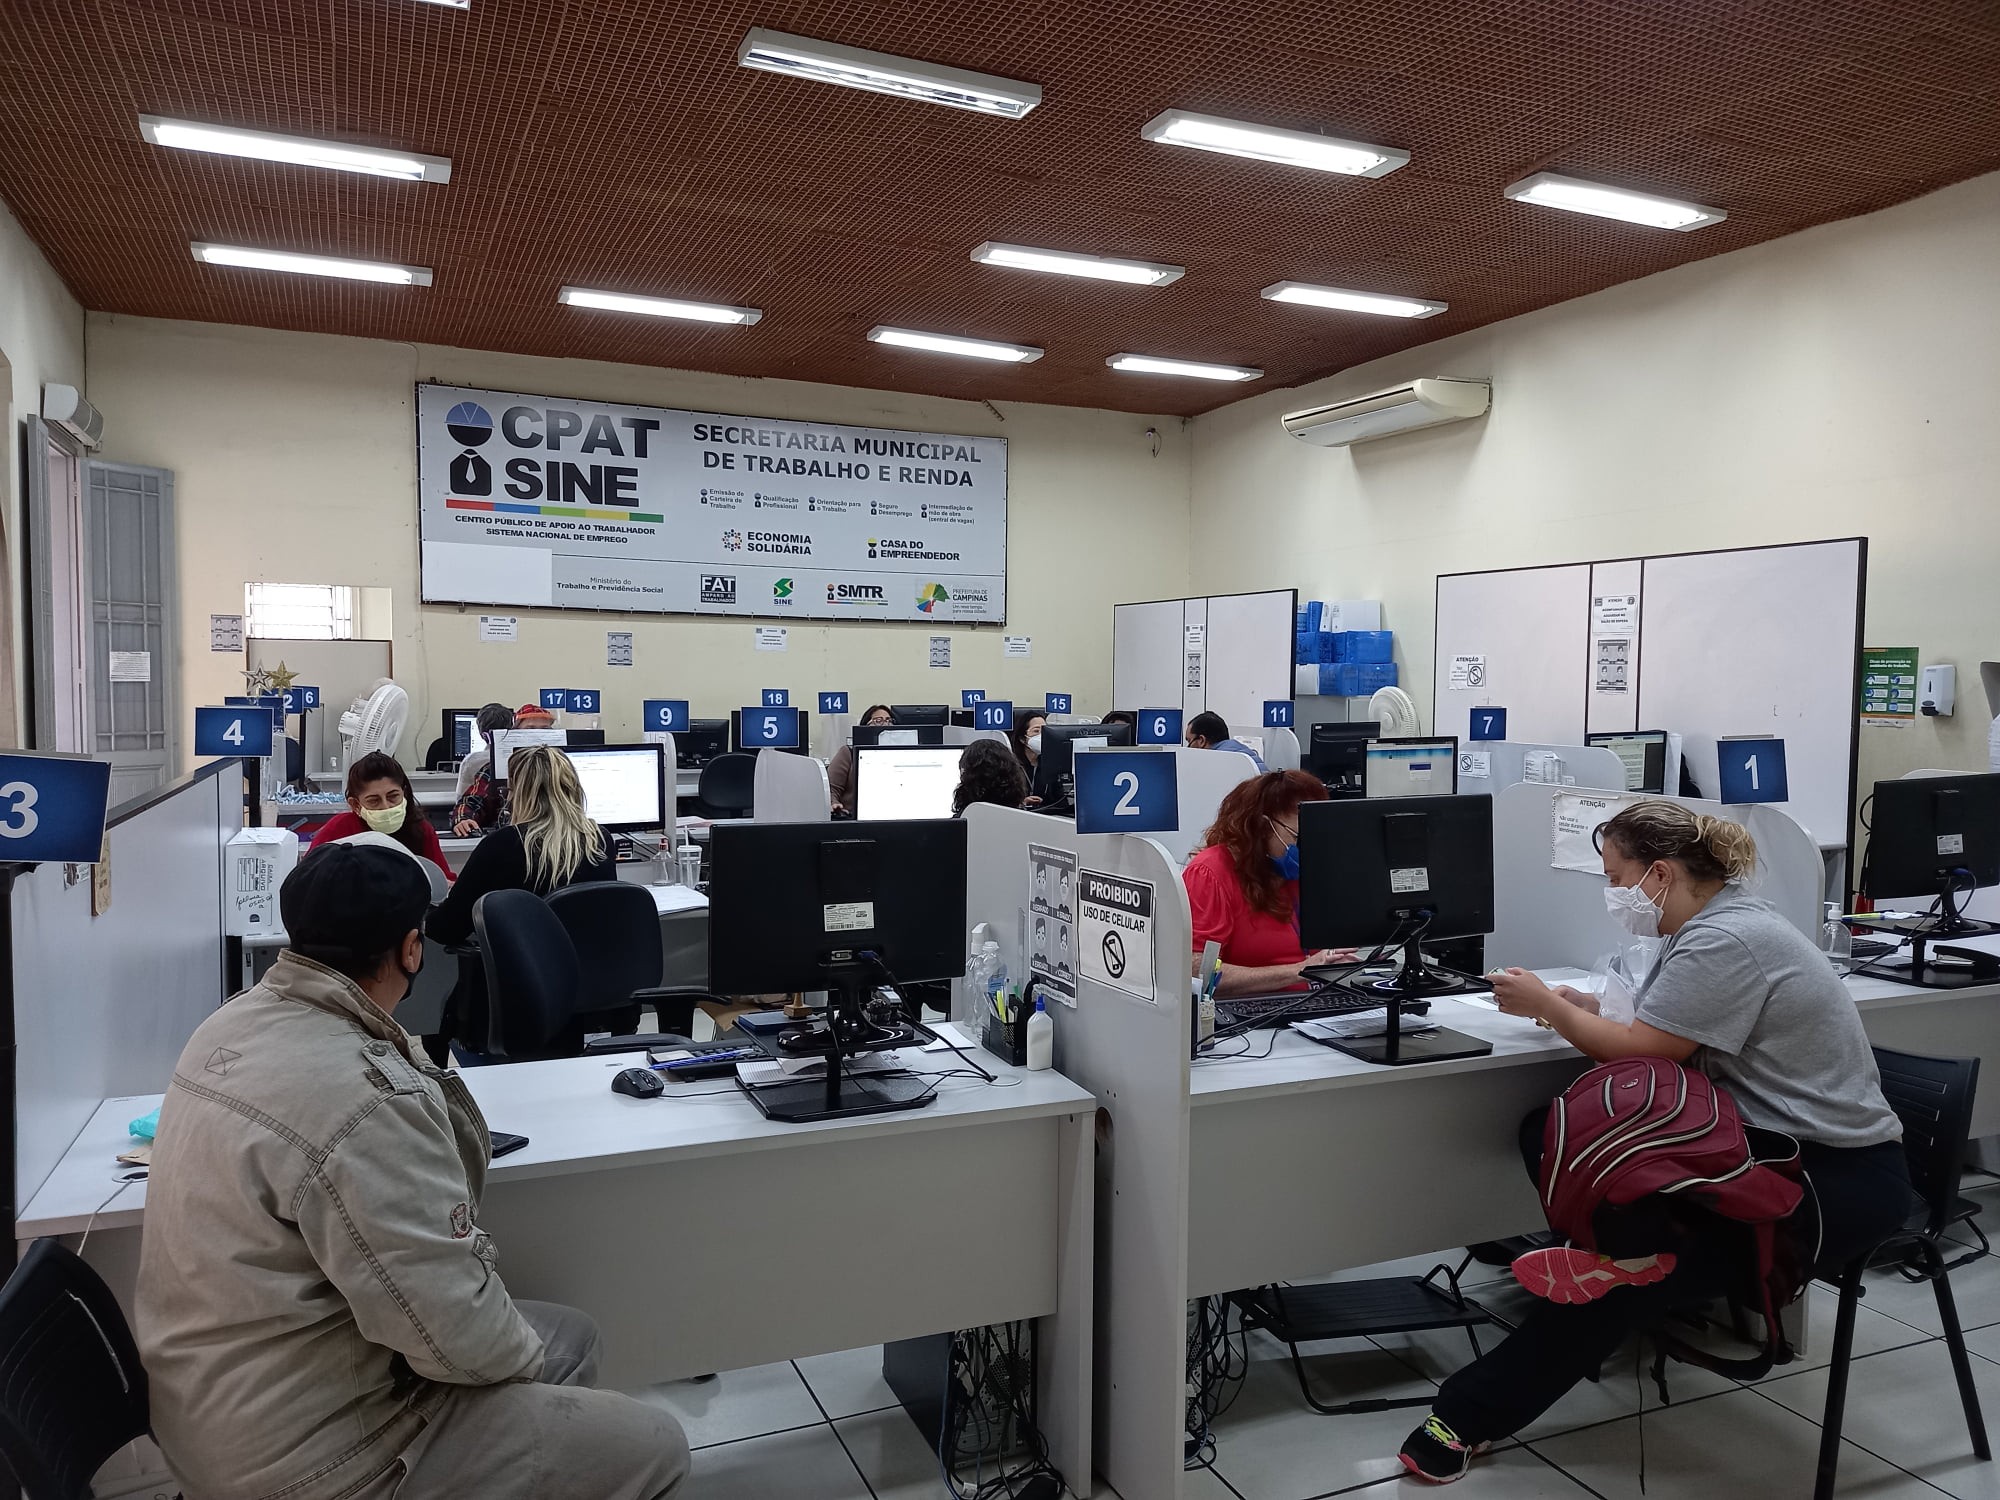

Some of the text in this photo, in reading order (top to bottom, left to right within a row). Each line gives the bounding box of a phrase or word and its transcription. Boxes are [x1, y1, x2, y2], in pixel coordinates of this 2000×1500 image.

[502, 406, 660, 458] CPAT
[693, 424, 981, 463] SECRETARIA MUNICIPAL
[703, 451, 973, 487] DE TRABALHO E RENDA
[504, 457, 640, 507] SINE
[710, 502, 736, 510] Trabalho
[762, 502, 798, 510] Profissional
[822, 505, 847, 513] Trabalho
[455, 515, 656, 535] CENTRO PÚBLICO DE APOIO AO TRABALHADOR
[486, 528, 628, 544] SISTEMA NACIONAL DE EMPREGO
[747, 531, 812, 544] ECONOMIA
[747, 542, 812, 555] SOLIDÁRIA
[880, 539, 924, 549] CASA DO
[880, 550, 960, 561] EMPREENDEDOR
[556, 582, 590, 590] Trabalho
[598, 584, 640, 593] Previdência
[590, 577, 621, 585] Ministério
[701, 577, 736, 592] FAT
[837, 584, 884, 599] SMTR
[952, 594, 988, 602] CAMPINAS
[546, 693, 563, 705] 17
[573, 695, 593, 709] 13
[767, 693, 783, 705] 18
[825, 696, 842, 710] 14
[1051, 697, 1066, 710] 15
[659, 707, 673, 726] 9
[983, 707, 1005, 724] 10
[1270, 706, 1287, 723] 11
[762, 716, 779, 739] 5
[1153, 716, 1167, 737] 6
[1483, 715, 1493, 734] 7
[222, 719, 245, 746] 4
[1744, 754, 1761, 790] 1
[1113, 771, 1140, 816] 2
[0, 781, 39, 839] 3
[1579, 800, 1606, 808] ATENÇÃO
[1089, 880, 1141, 908] PROIBIDO
[1083, 905, 1145, 933] USO DE CELULAR
